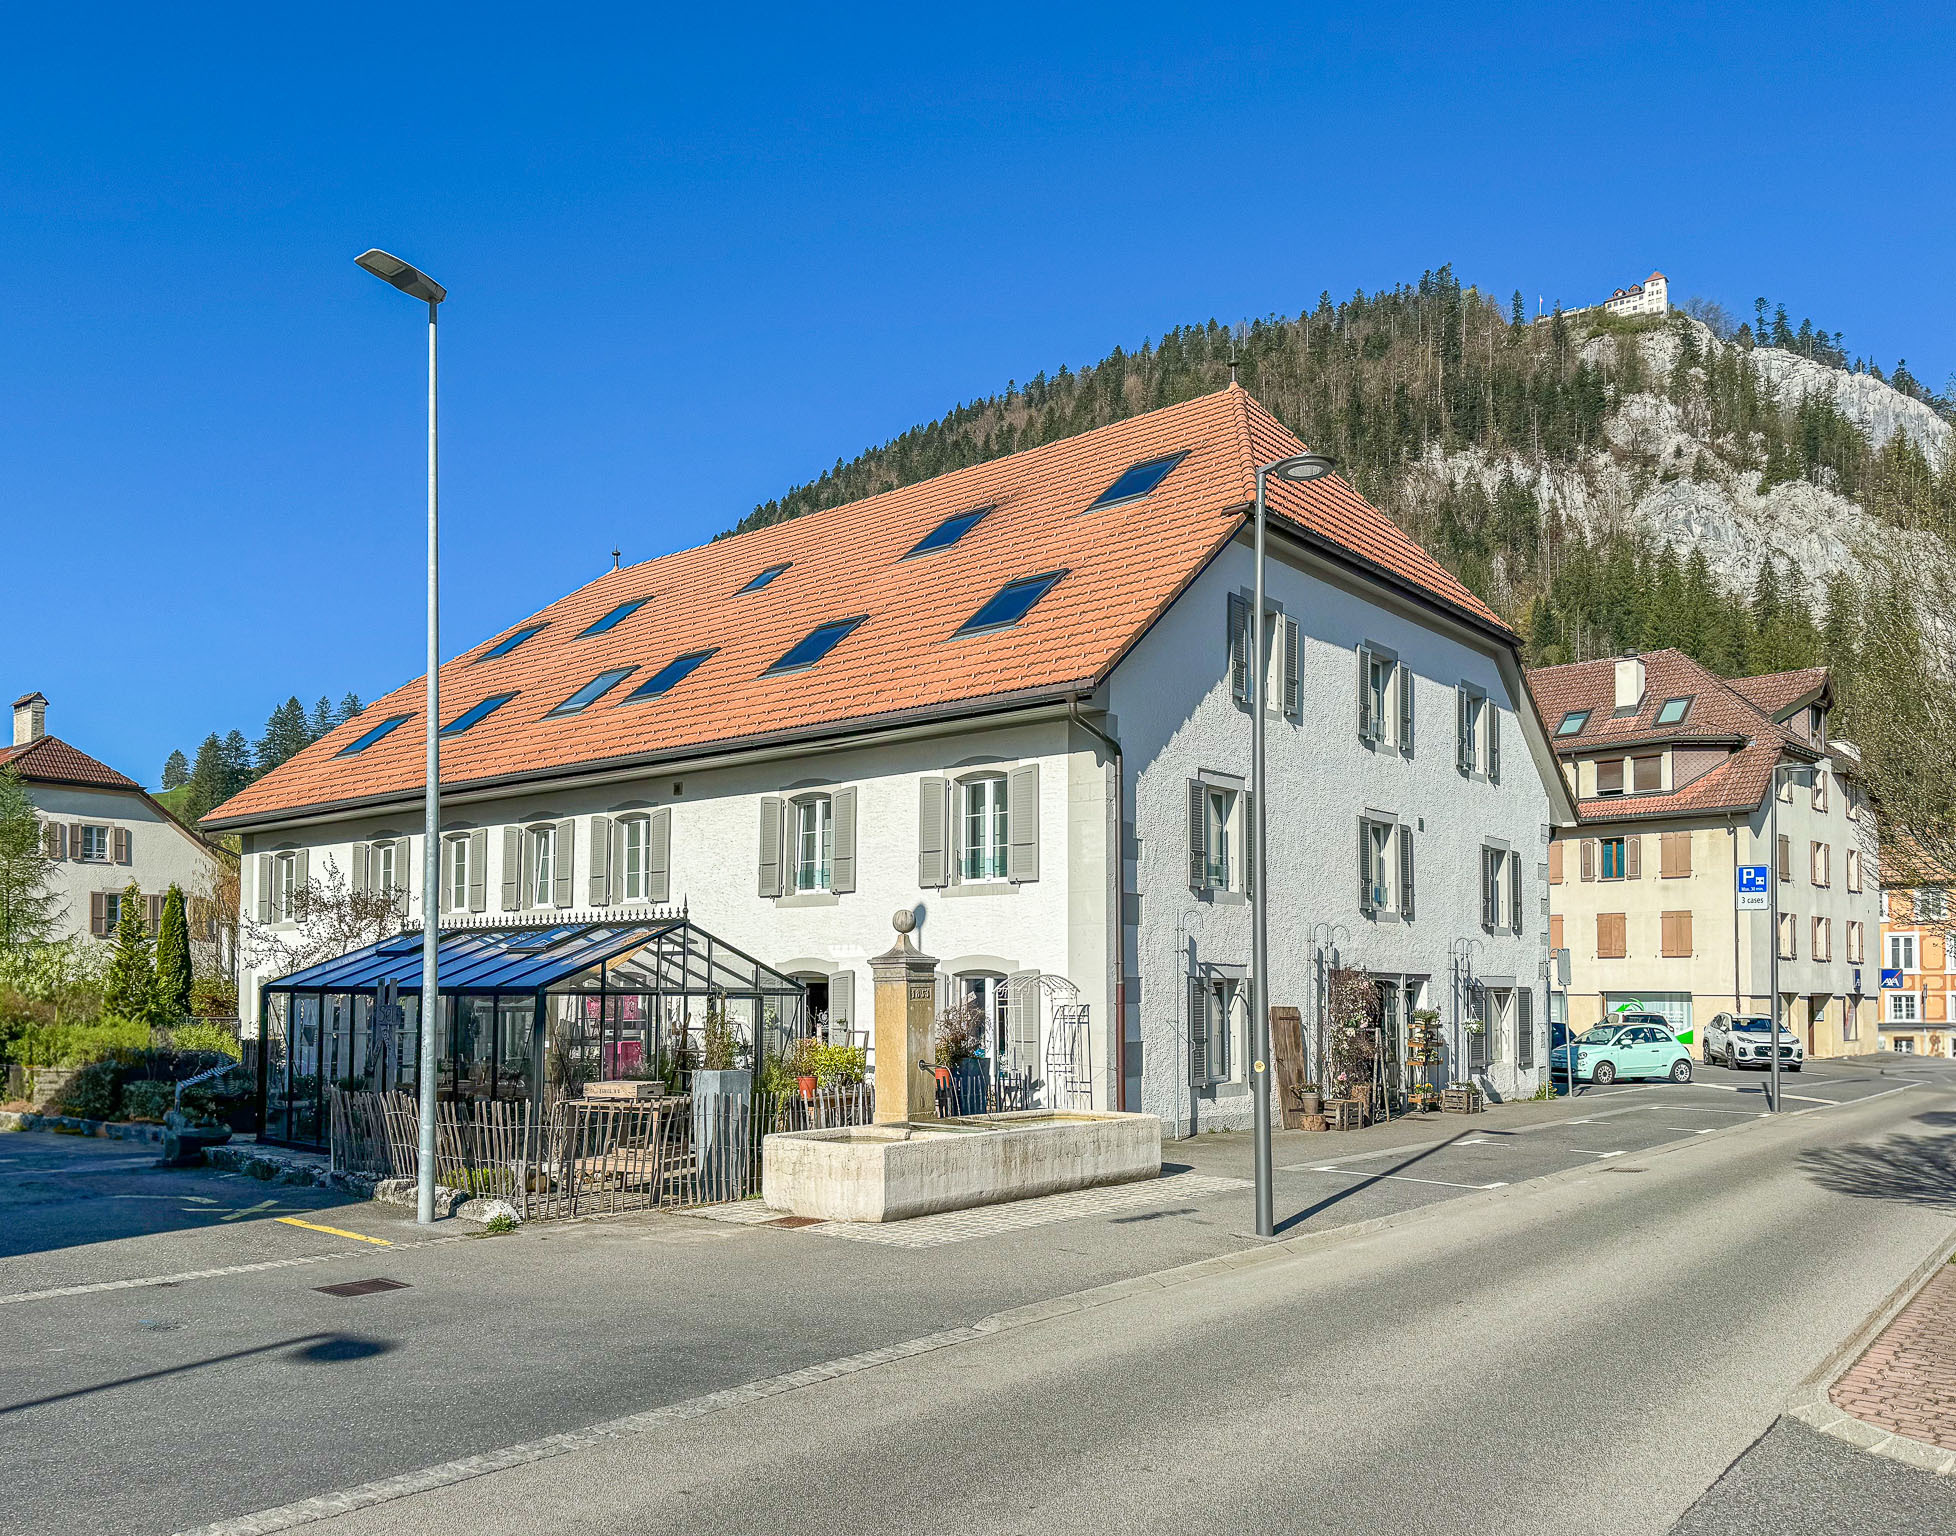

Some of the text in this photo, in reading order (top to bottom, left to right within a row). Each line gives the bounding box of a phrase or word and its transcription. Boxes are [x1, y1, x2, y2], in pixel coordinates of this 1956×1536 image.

[1743, 868, 1755, 884] P
[1741, 896, 1746, 904] 3
[1880, 977, 1900, 987] AXA
